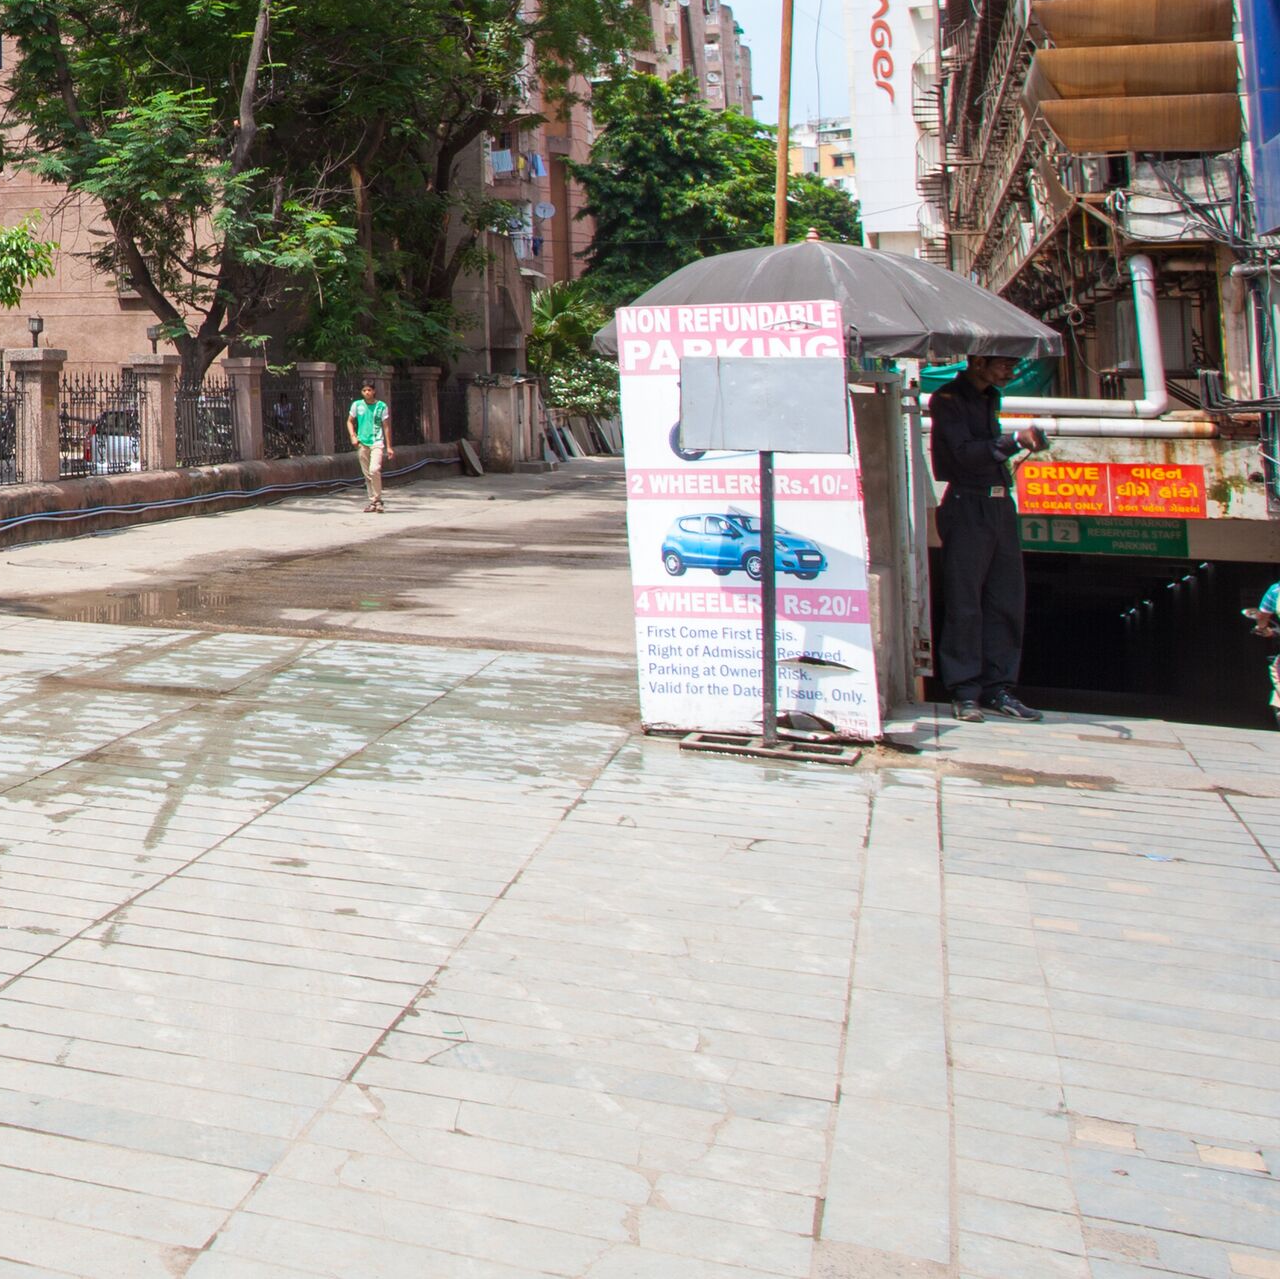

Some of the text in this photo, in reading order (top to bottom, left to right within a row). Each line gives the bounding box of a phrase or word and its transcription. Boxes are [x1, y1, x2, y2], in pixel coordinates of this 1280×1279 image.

[620, 302, 838, 334] NON REFUNDABLE
[1024, 466, 1100, 480] DRIVE
[631, 474, 644, 494] 2
[775, 474, 849, 496] Rs.10/-
[1027, 483, 1097, 497] SLOW
[1024, 500, 1104, 511] 1st GEAR ONLY
[1134, 520, 1181, 528] PARKING
[1060, 529, 1071, 541] 2
[1088, 528, 1140, 538] RESERVED
[1151, 530, 1182, 539] STAFF
[1111, 541, 1158, 551] PARKING
[636, 591, 860, 616] 4 WHEELER Rs.20/-
[647, 626, 797, 641] First Come First Bsis.
[648, 644, 684, 658] Right
[686, 645, 700, 657] of
[704, 646, 763, 658] Admissio
[649, 663, 813, 681] Parking at Owner Risk.
[649, 682, 683, 694] Valid
[687, 682, 705, 695] for
[707, 683, 729, 696] the
[734, 685, 764, 697] Date
[786, 687, 828, 701] Issue,
[831, 689, 868, 705] Only.
